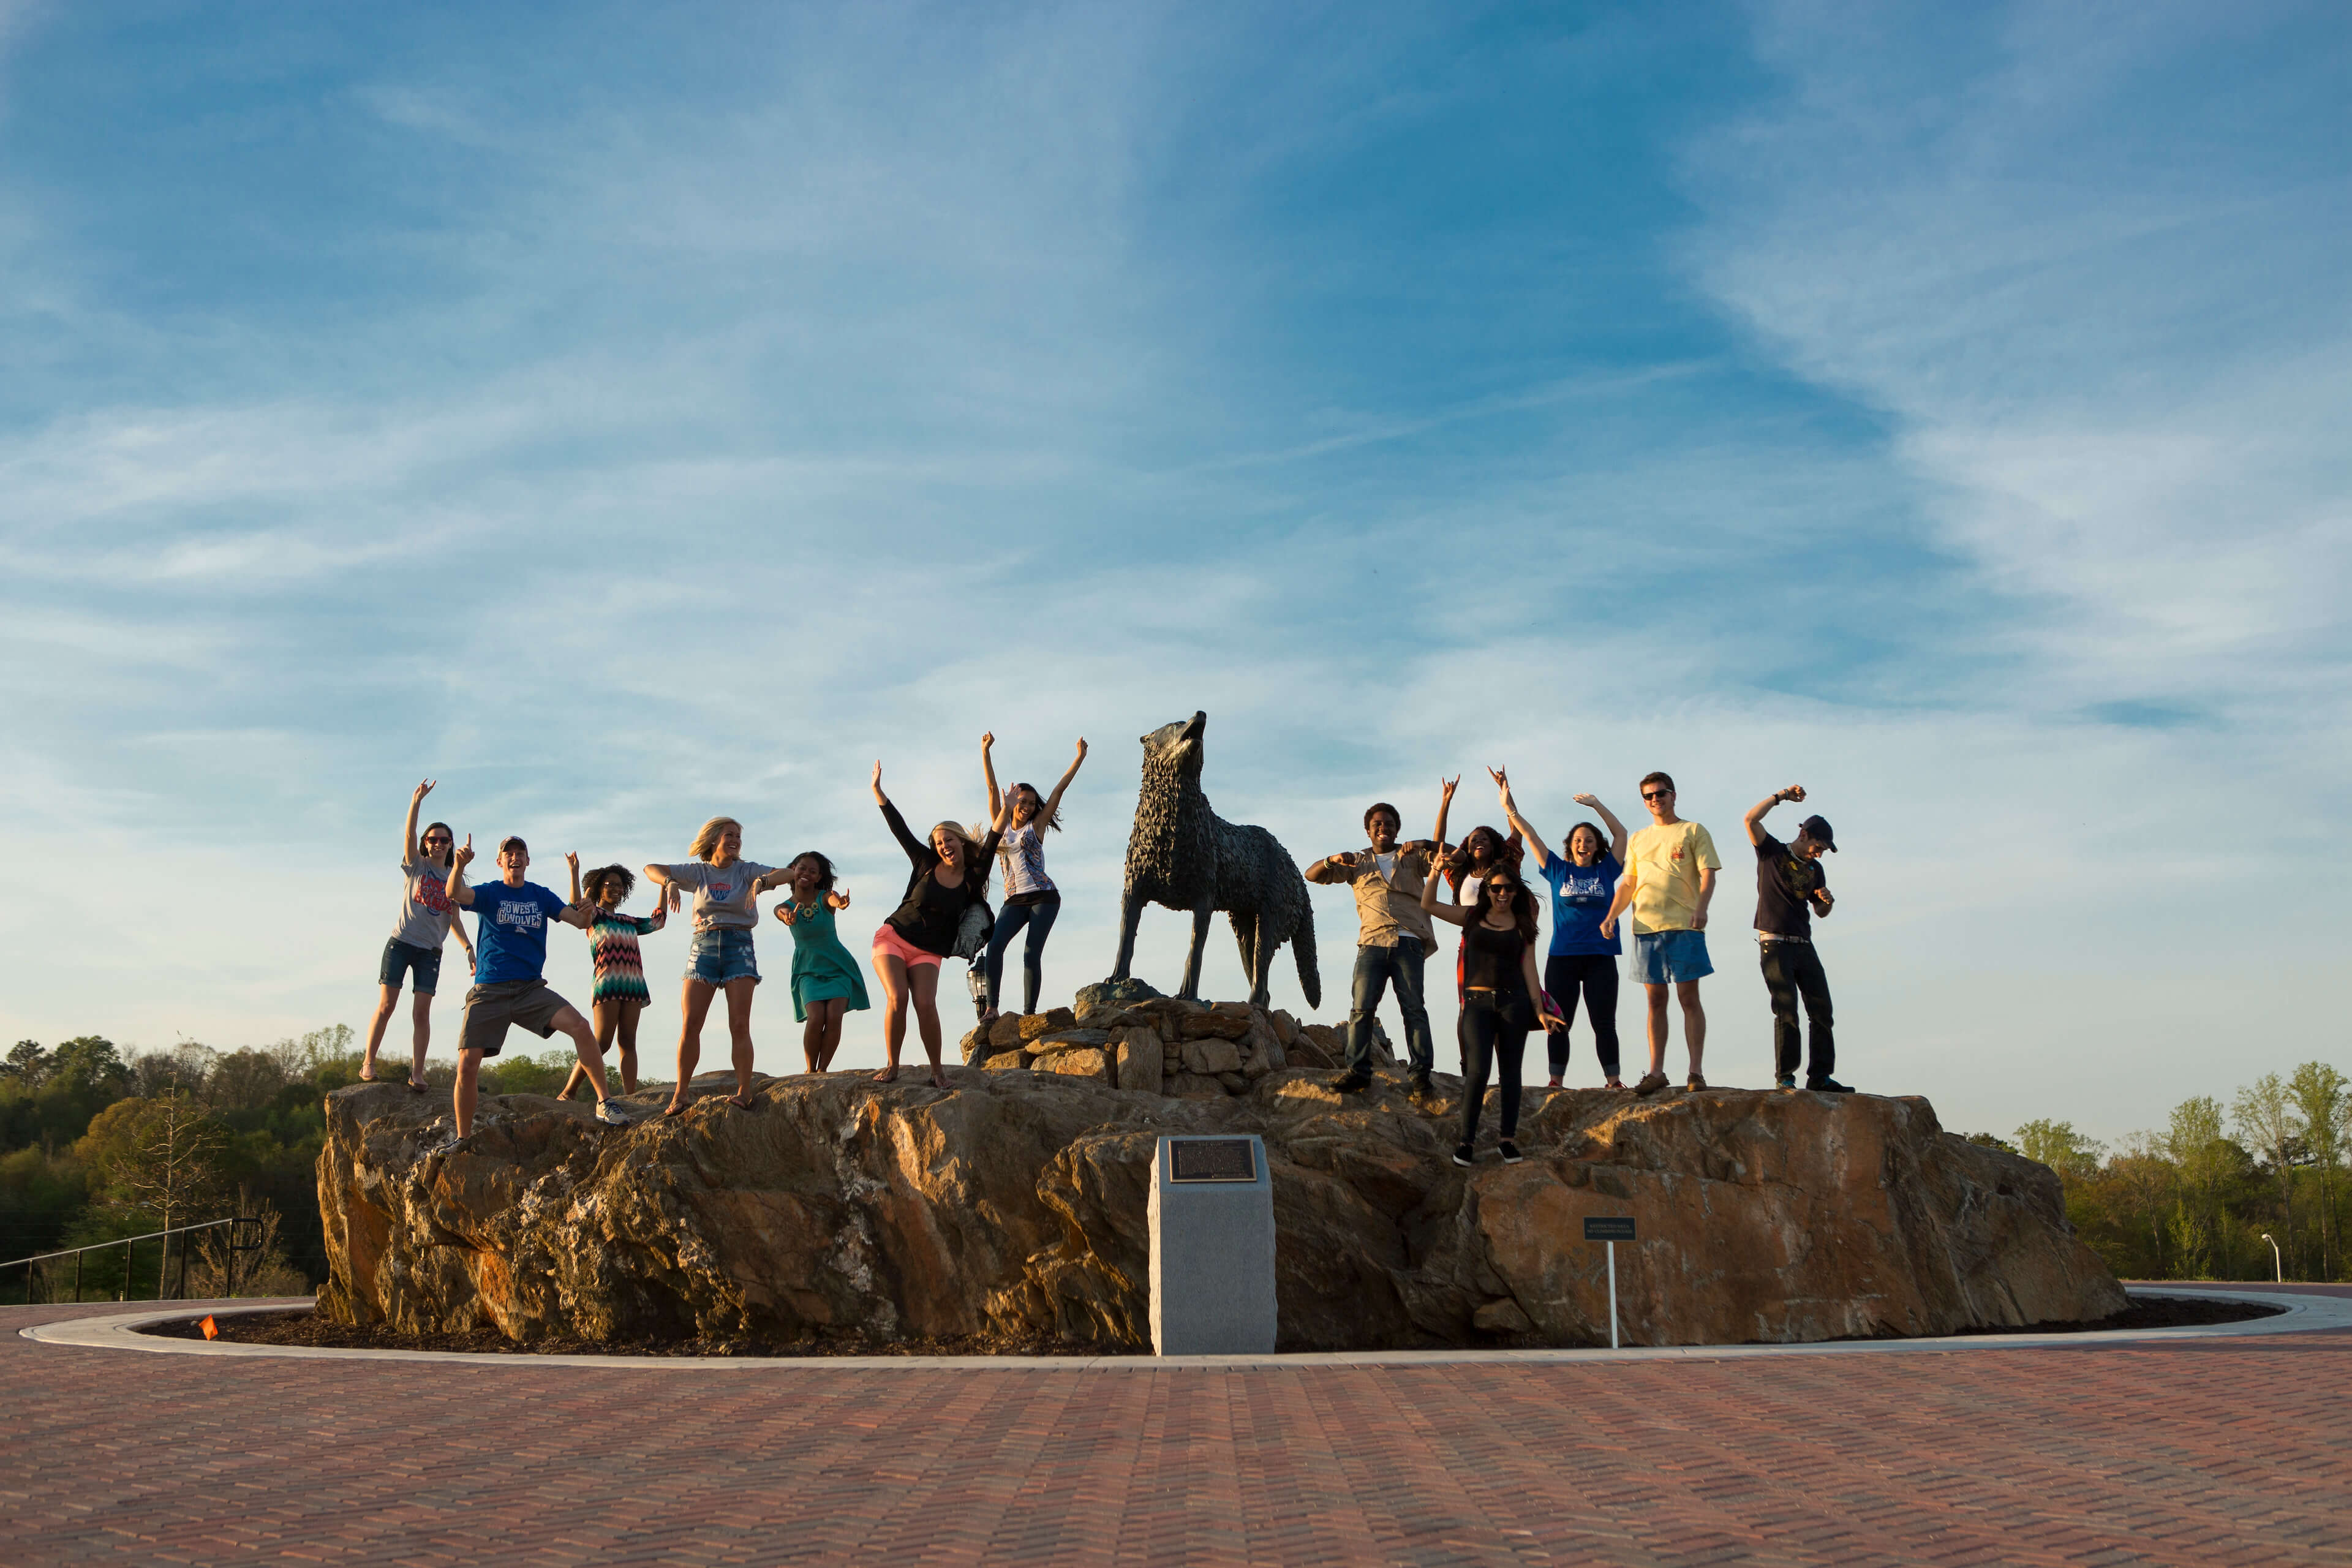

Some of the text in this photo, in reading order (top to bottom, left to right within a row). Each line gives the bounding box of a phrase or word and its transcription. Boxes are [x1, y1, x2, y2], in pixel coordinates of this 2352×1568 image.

[421, 874, 448, 892] UW
[511, 903, 536, 914] WEST
[509, 913, 543, 927] WOLVES
